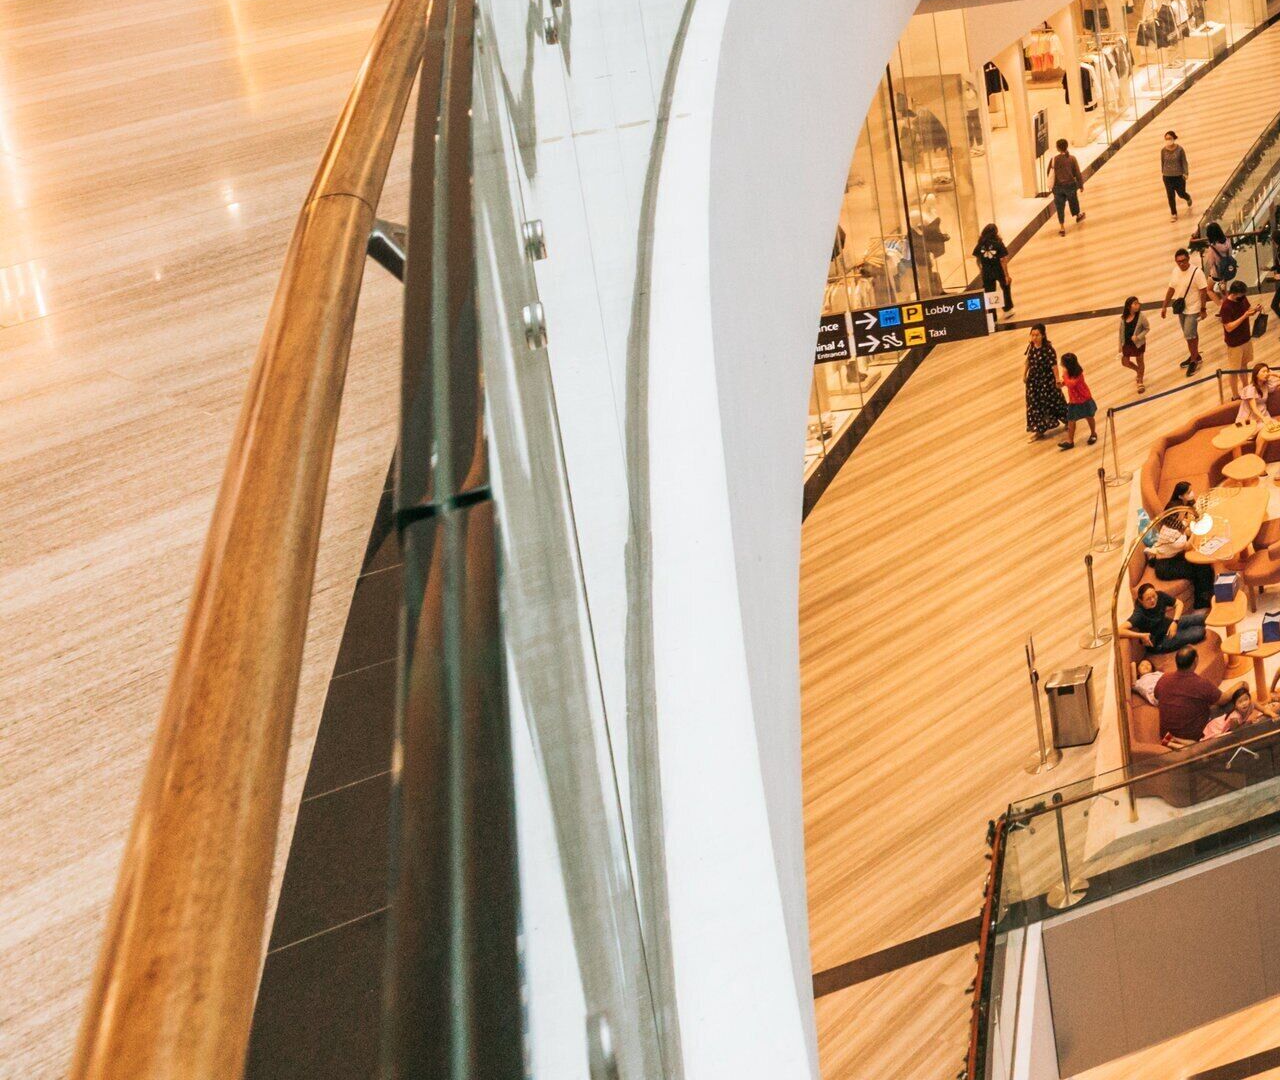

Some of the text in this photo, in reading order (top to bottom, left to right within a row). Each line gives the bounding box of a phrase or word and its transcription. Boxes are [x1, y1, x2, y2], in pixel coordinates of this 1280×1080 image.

[989, 296, 1000, 305] L2
[907, 302, 965, 321] P Lobby C
[928, 328, 947, 338] Taxi
[837, 339, 845, 349] 4
